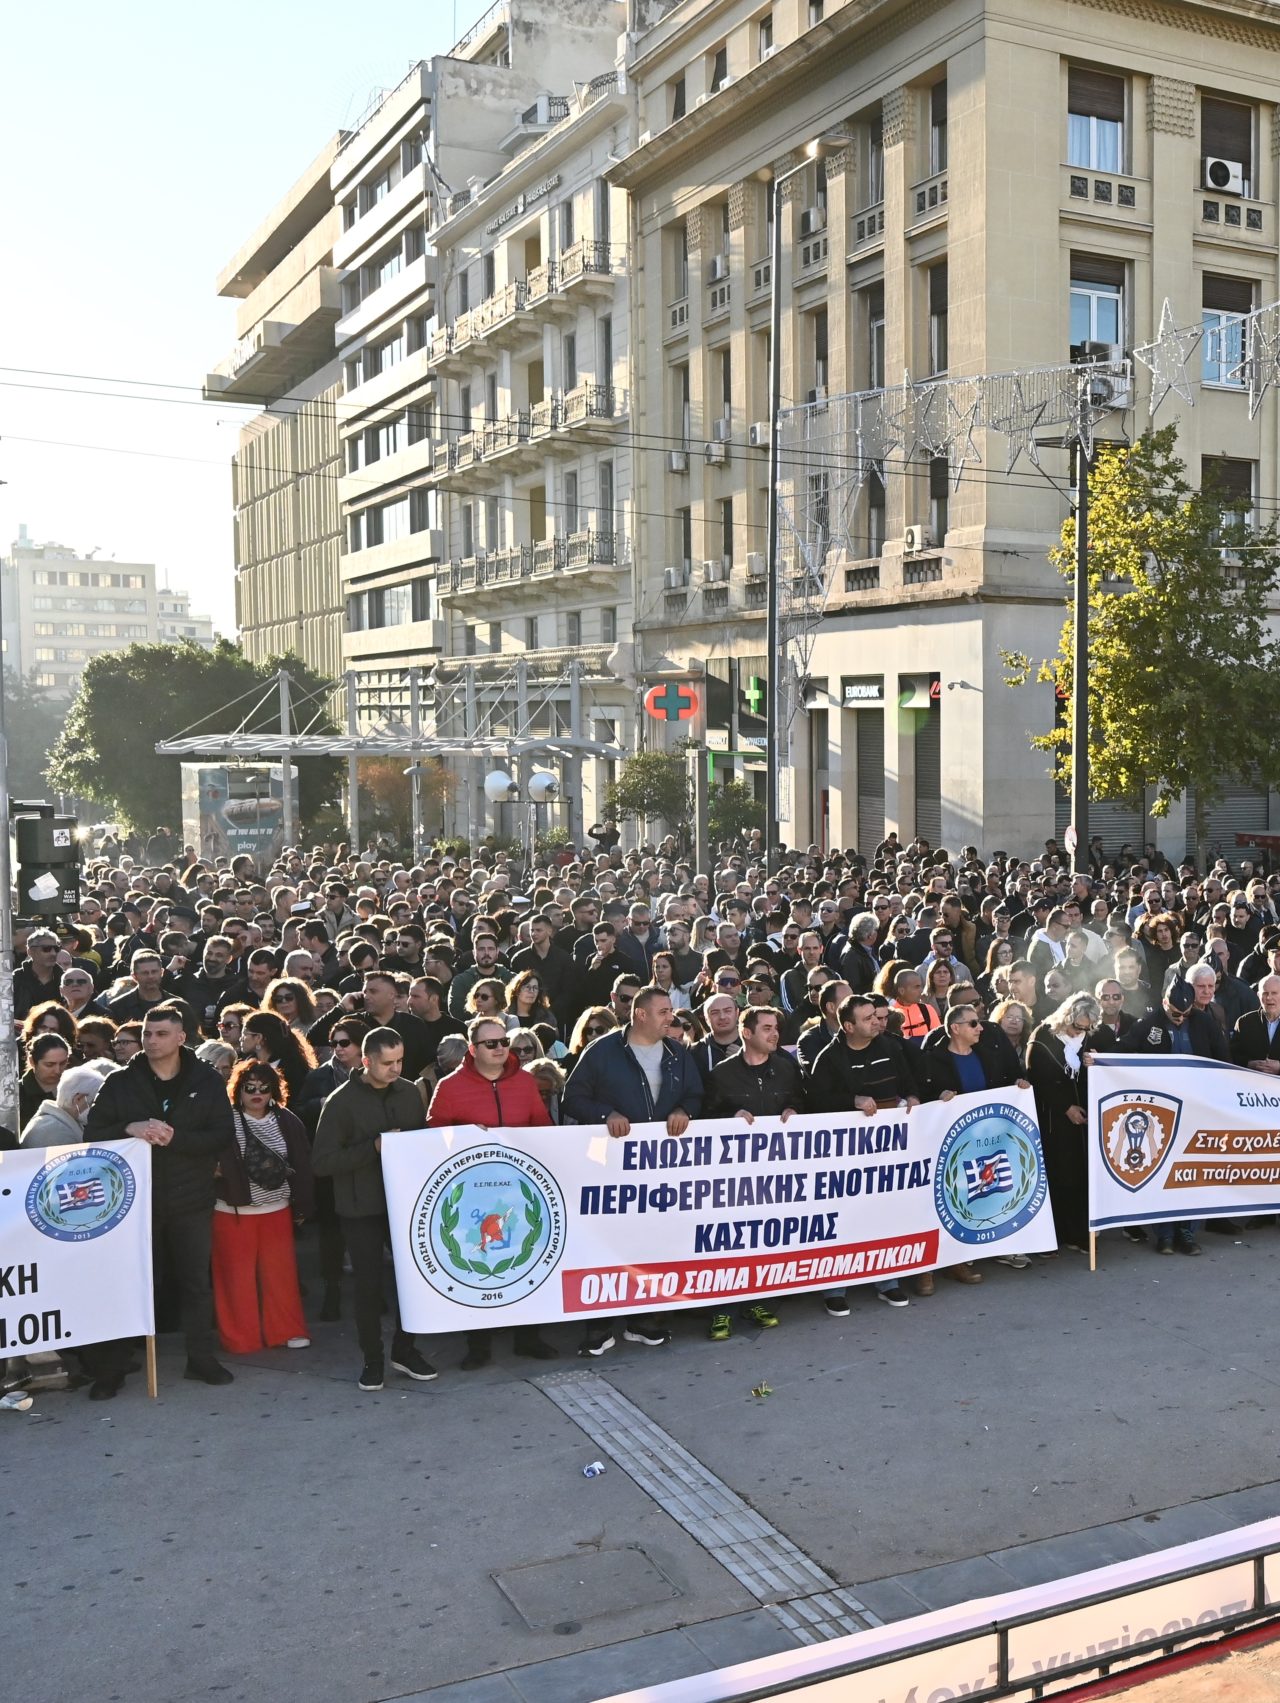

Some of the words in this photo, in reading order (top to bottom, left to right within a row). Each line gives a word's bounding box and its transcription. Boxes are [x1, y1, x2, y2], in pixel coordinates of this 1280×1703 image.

[845, 685, 880, 699] EUROBANK
[237, 841, 257, 851] play
[942, 1106, 995, 1152] ΟΜΟΣΠΟΝΔΙΑ
[999, 1106, 1035, 1134] ΕΝΩΣΕΩΝ
[452, 1150, 526, 1170] ΠΕΡΙΦΕΡΕΙΑΚΗΣ
[622, 1135, 712, 1171] ΕΝΩΣΗ
[718, 1122, 909, 1166] ΣΤΡΑΤΙΩΤΙΚΩΝ
[1195, 1132, 1229, 1152] Στις
[526, 1162, 559, 1208] ΕΝΟΤΗΤΑΣ
[579, 1172, 807, 1216] ΠΕΡΙΦΕΡΕΙΑΚΗΣ
[814, 1157, 932, 1201] ΕΝΟΤΗΤΑΣ
[935, 1155, 955, 1231] ΠΑΝΕΛΛΑΔΙΚΗ
[1174, 1168, 1197, 1182] και
[417, 1167, 453, 1239] ΣΤΡΑΤΙΩΤΙΚΩΝ
[542, 1207, 561, 1267] ΚΑΣΤΟΡΙΑΣ
[693, 1211, 839, 1254] ΚΑΣΤΟΡΙΑΣ
[976, 1231, 996, 1242] 2013
[418, 1241, 437, 1275] ΕΝΩΣΗ
[579, 1273, 629, 1305] ΟΧΙ
[634, 1271, 680, 1298] ΣΤΟ
[681, 1264, 751, 1294] ΣΩΜΑ
[755, 1241, 927, 1288] ΥΠΑΞΙΩΜΑΤΙΚΩΝ
[0, 1262, 38, 1298] ΚΗ
[480, 1291, 503, 1302] 2016
